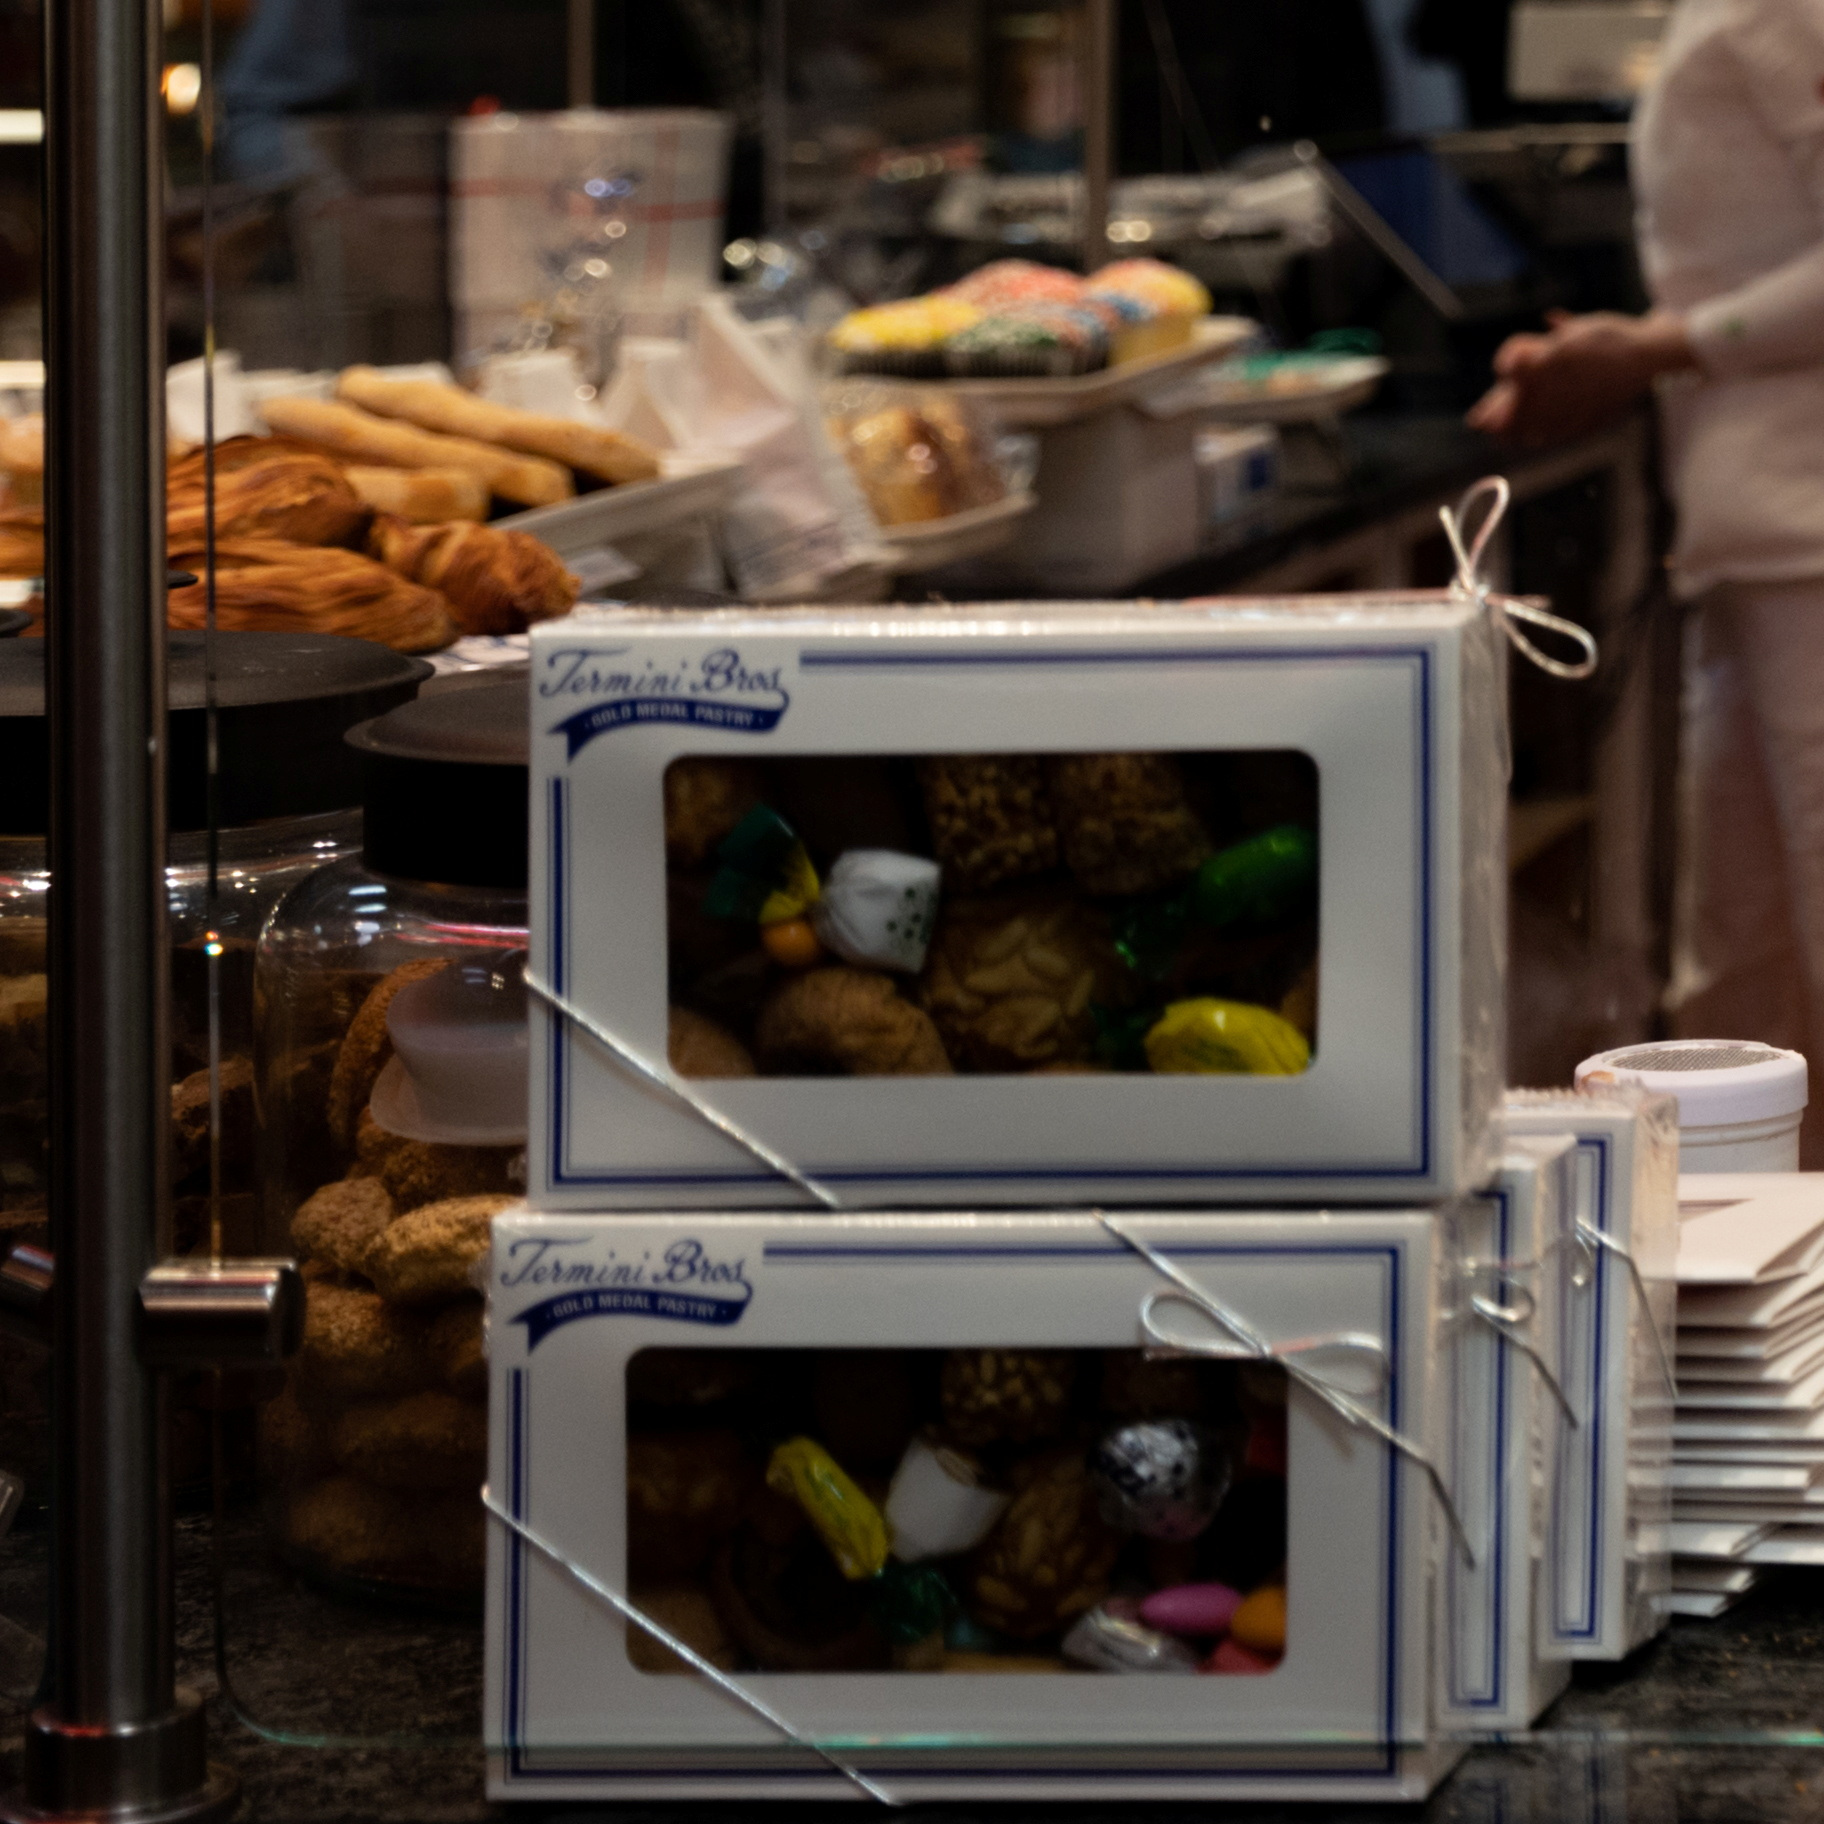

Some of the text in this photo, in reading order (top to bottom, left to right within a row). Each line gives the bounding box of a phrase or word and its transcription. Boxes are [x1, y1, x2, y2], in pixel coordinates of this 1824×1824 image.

[538, 647, 687, 697] Termini
[590, 702, 755, 727] GOLD MEDAL PASTRY
[500, 1236, 650, 1287] Termini
[552, 1293, 718, 1318] GOLD MEDAL PASTRY
